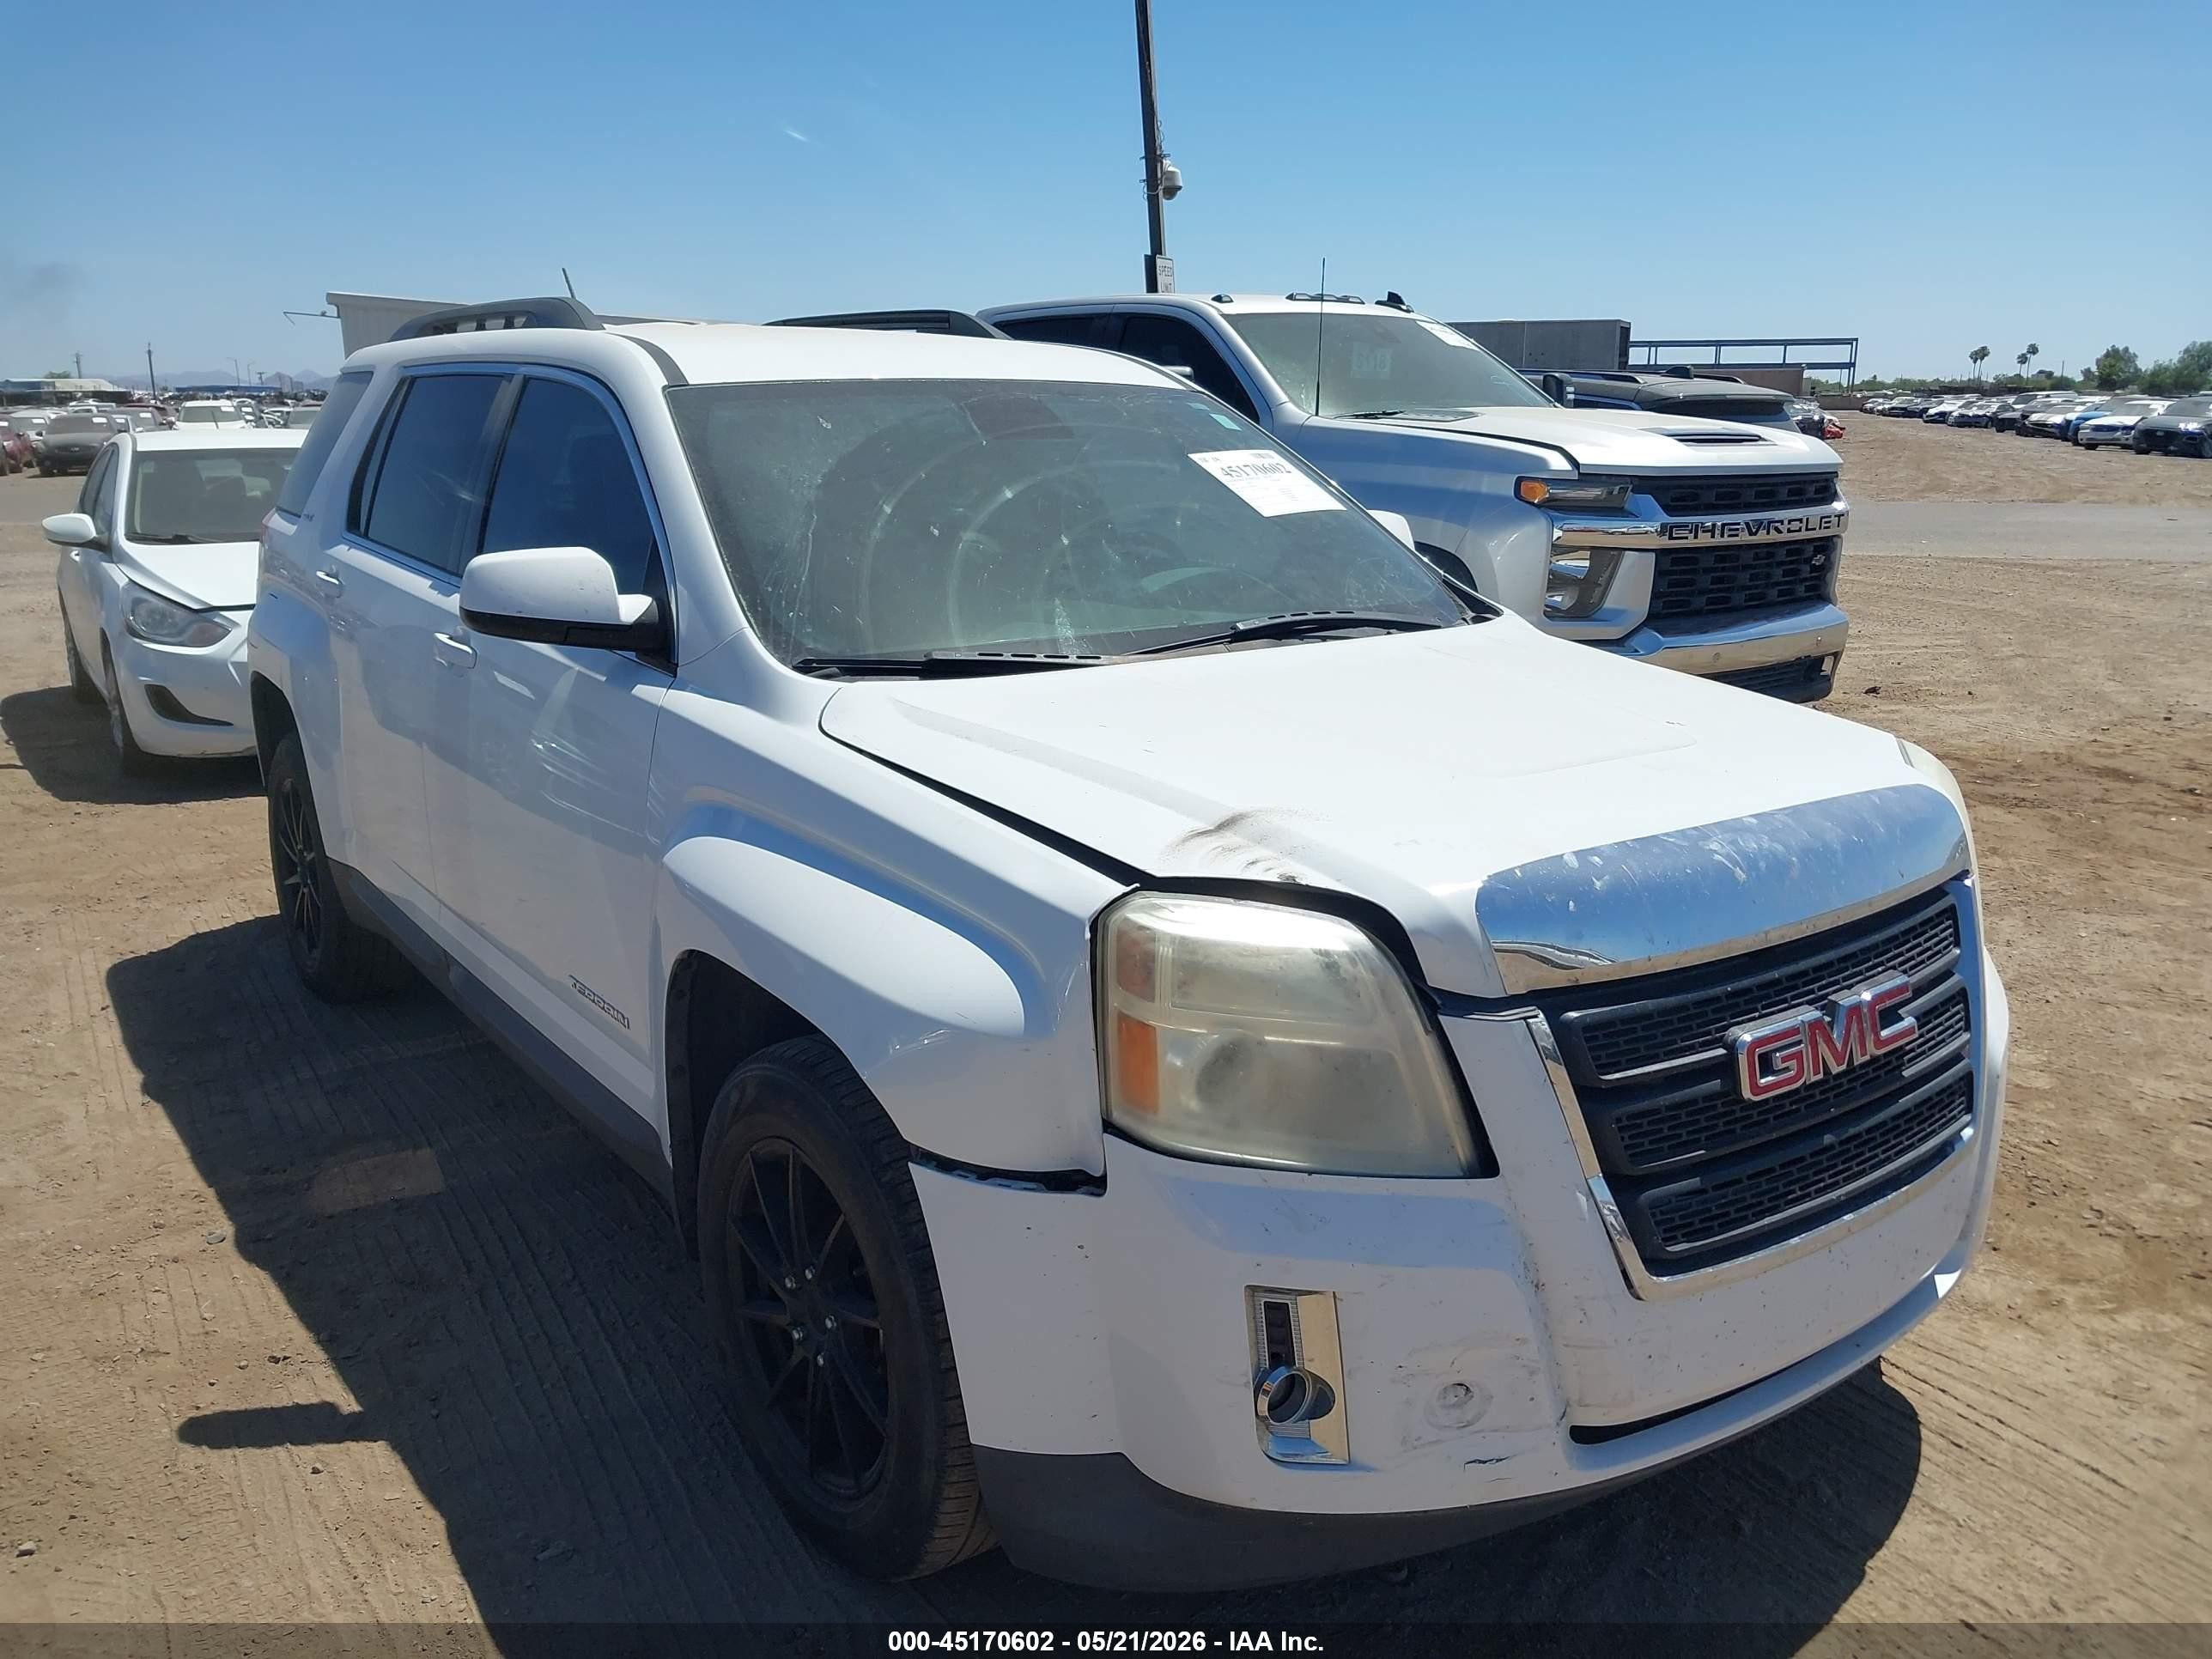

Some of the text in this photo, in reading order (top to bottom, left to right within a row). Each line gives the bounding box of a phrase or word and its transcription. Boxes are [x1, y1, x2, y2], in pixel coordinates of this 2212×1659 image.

[1220, 462, 1292, 478] 45170602
[1665, 513, 1846, 541] CHEVROLET
[1733, 971, 1919, 1102] GMC
